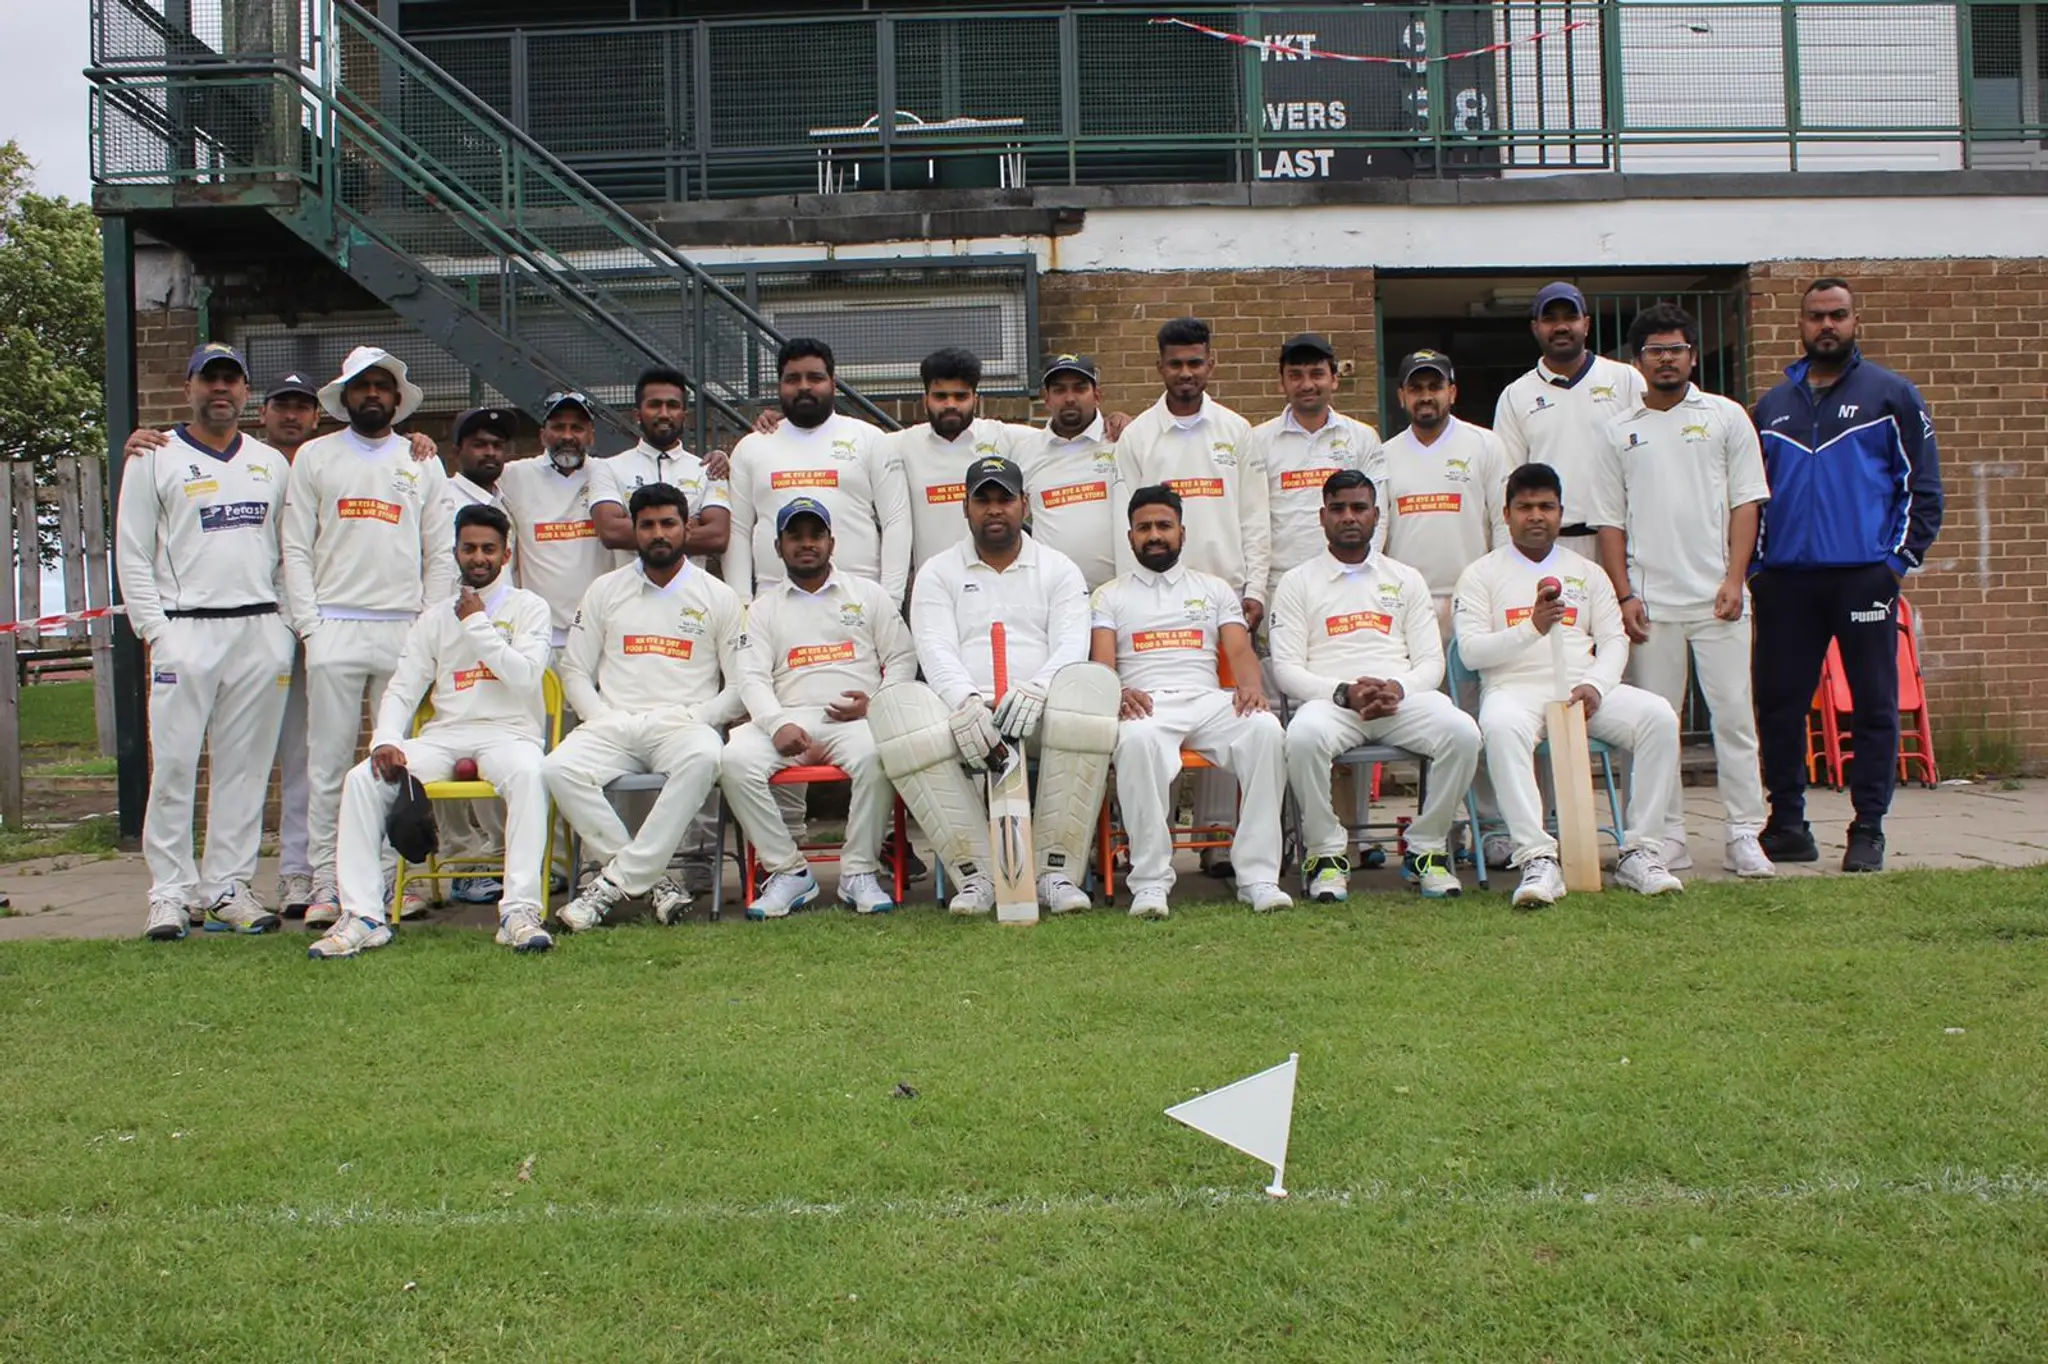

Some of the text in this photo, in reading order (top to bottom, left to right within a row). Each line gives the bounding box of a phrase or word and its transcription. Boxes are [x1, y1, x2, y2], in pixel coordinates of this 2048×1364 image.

[1261, 100, 1347, 131] VERS
[1258, 149, 1334, 178] LAST
[1837, 404, 1859, 419] NT
[1850, 609, 1886, 623] PUMA
